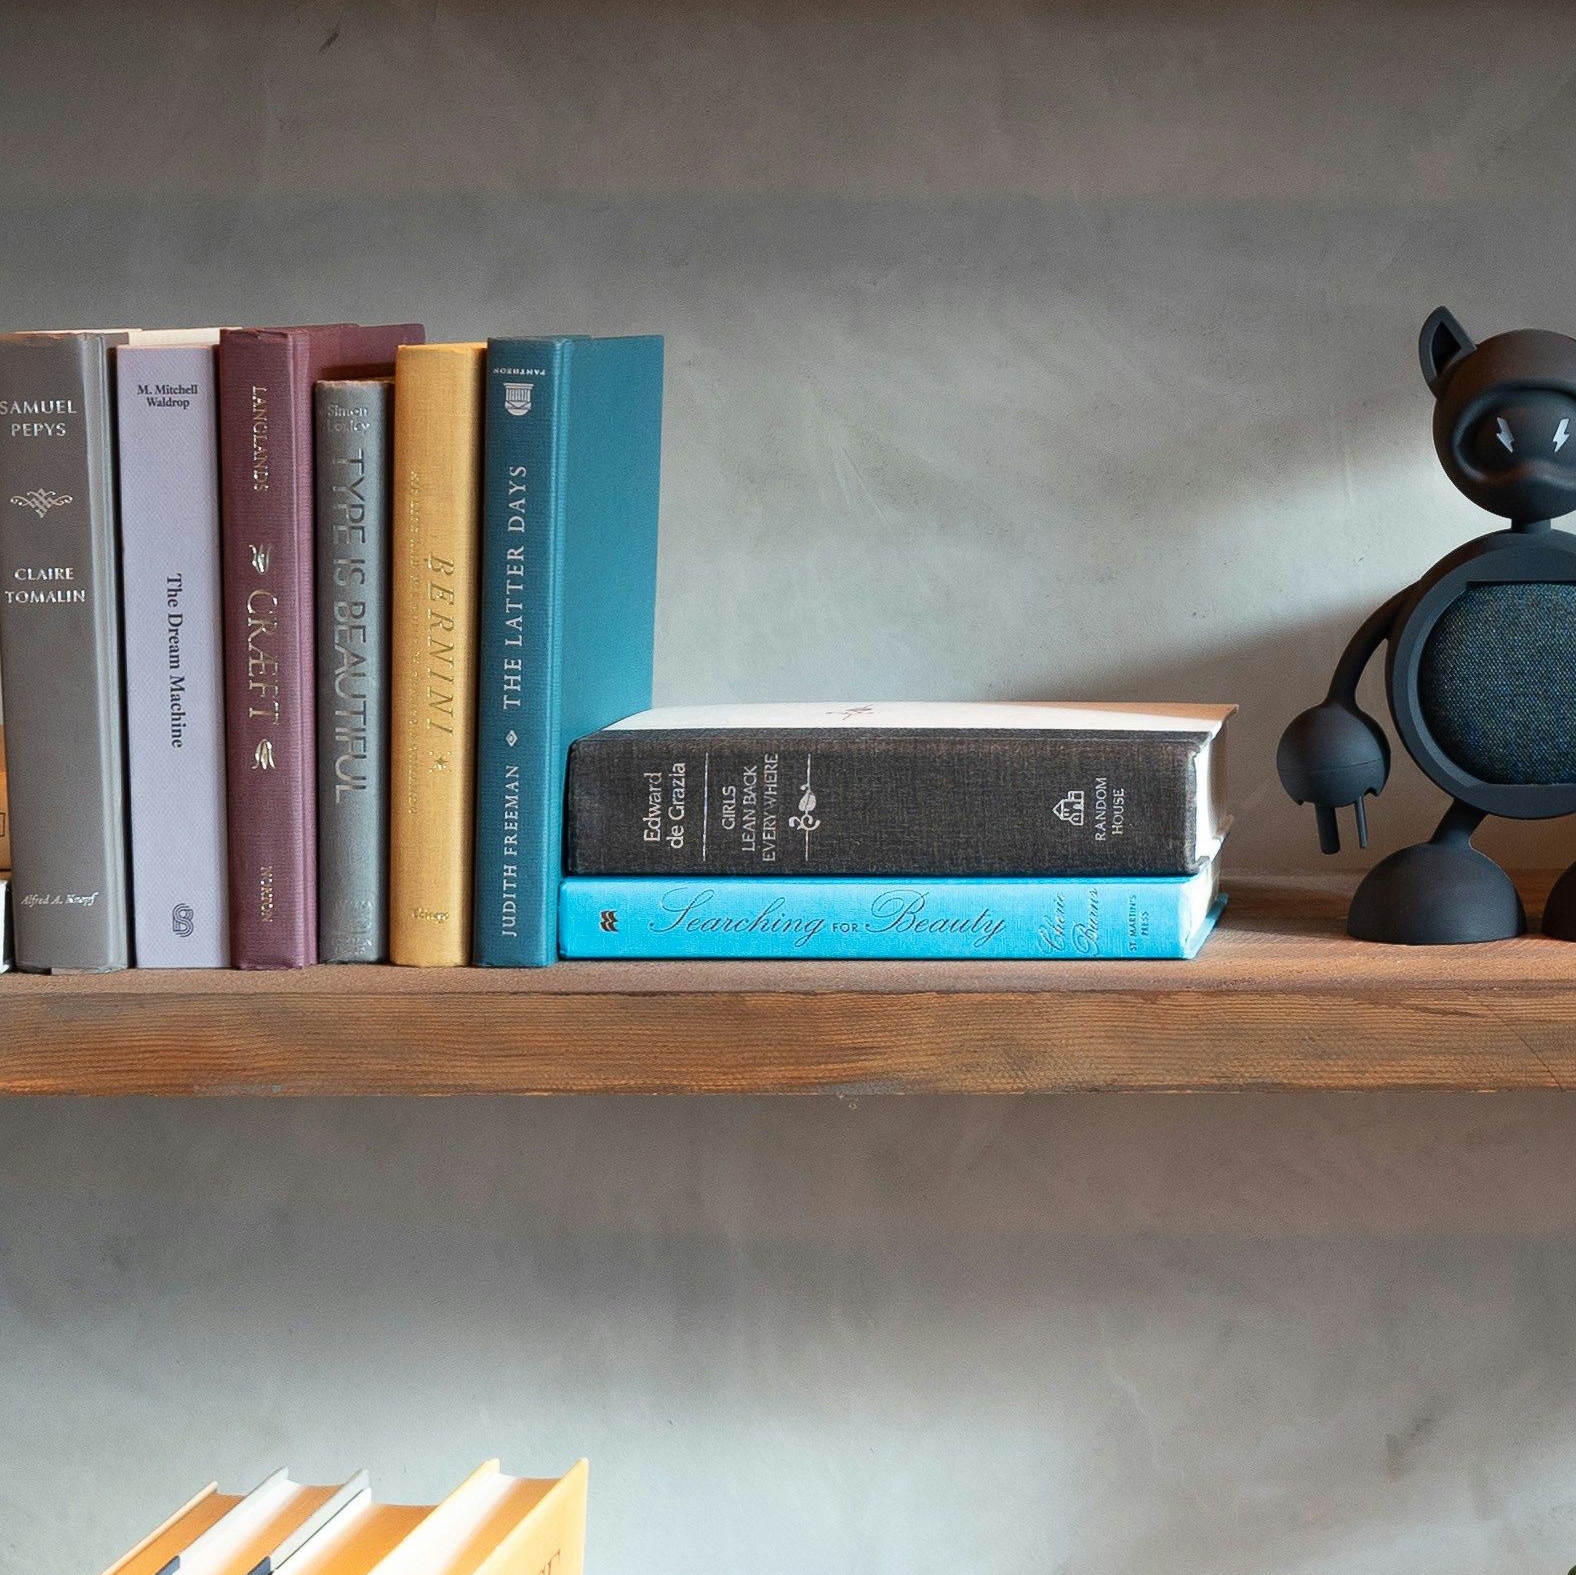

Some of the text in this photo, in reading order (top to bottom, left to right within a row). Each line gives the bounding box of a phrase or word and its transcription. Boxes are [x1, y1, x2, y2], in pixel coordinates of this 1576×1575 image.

[0, 399, 77, 415] SAMUEL
[137, 384, 199, 396] M. Mitchell
[146, 396, 190, 410] Waldrop
[11, 422, 67, 438] PEPYS
[4, 589, 87, 604] TOMALIN
[14, 567, 75, 581] CLAIRE
[503, 465, 527, 710] THE LATTER DAYS
[332, 448, 368, 805] TYPE IS BEAUTIFUL
[423, 553, 455, 737] BERNINI
[166, 573, 187, 749] The Dream Machine
[642, 772, 662, 842] Edward
[666, 762, 686, 849] de Grazia
[721, 785, 737, 830] GIRLS
[741, 764, 758, 852] LEAN BACK
[762, 752, 779, 862] EVERYWHERE
[1094, 777, 1107, 841] RANDOM
[1111, 787, 1125, 835] HOUSE
[501, 765, 520, 938] JUDITH FREEMAN
[649, 886, 1006, 948] Searching FOR Beauty
